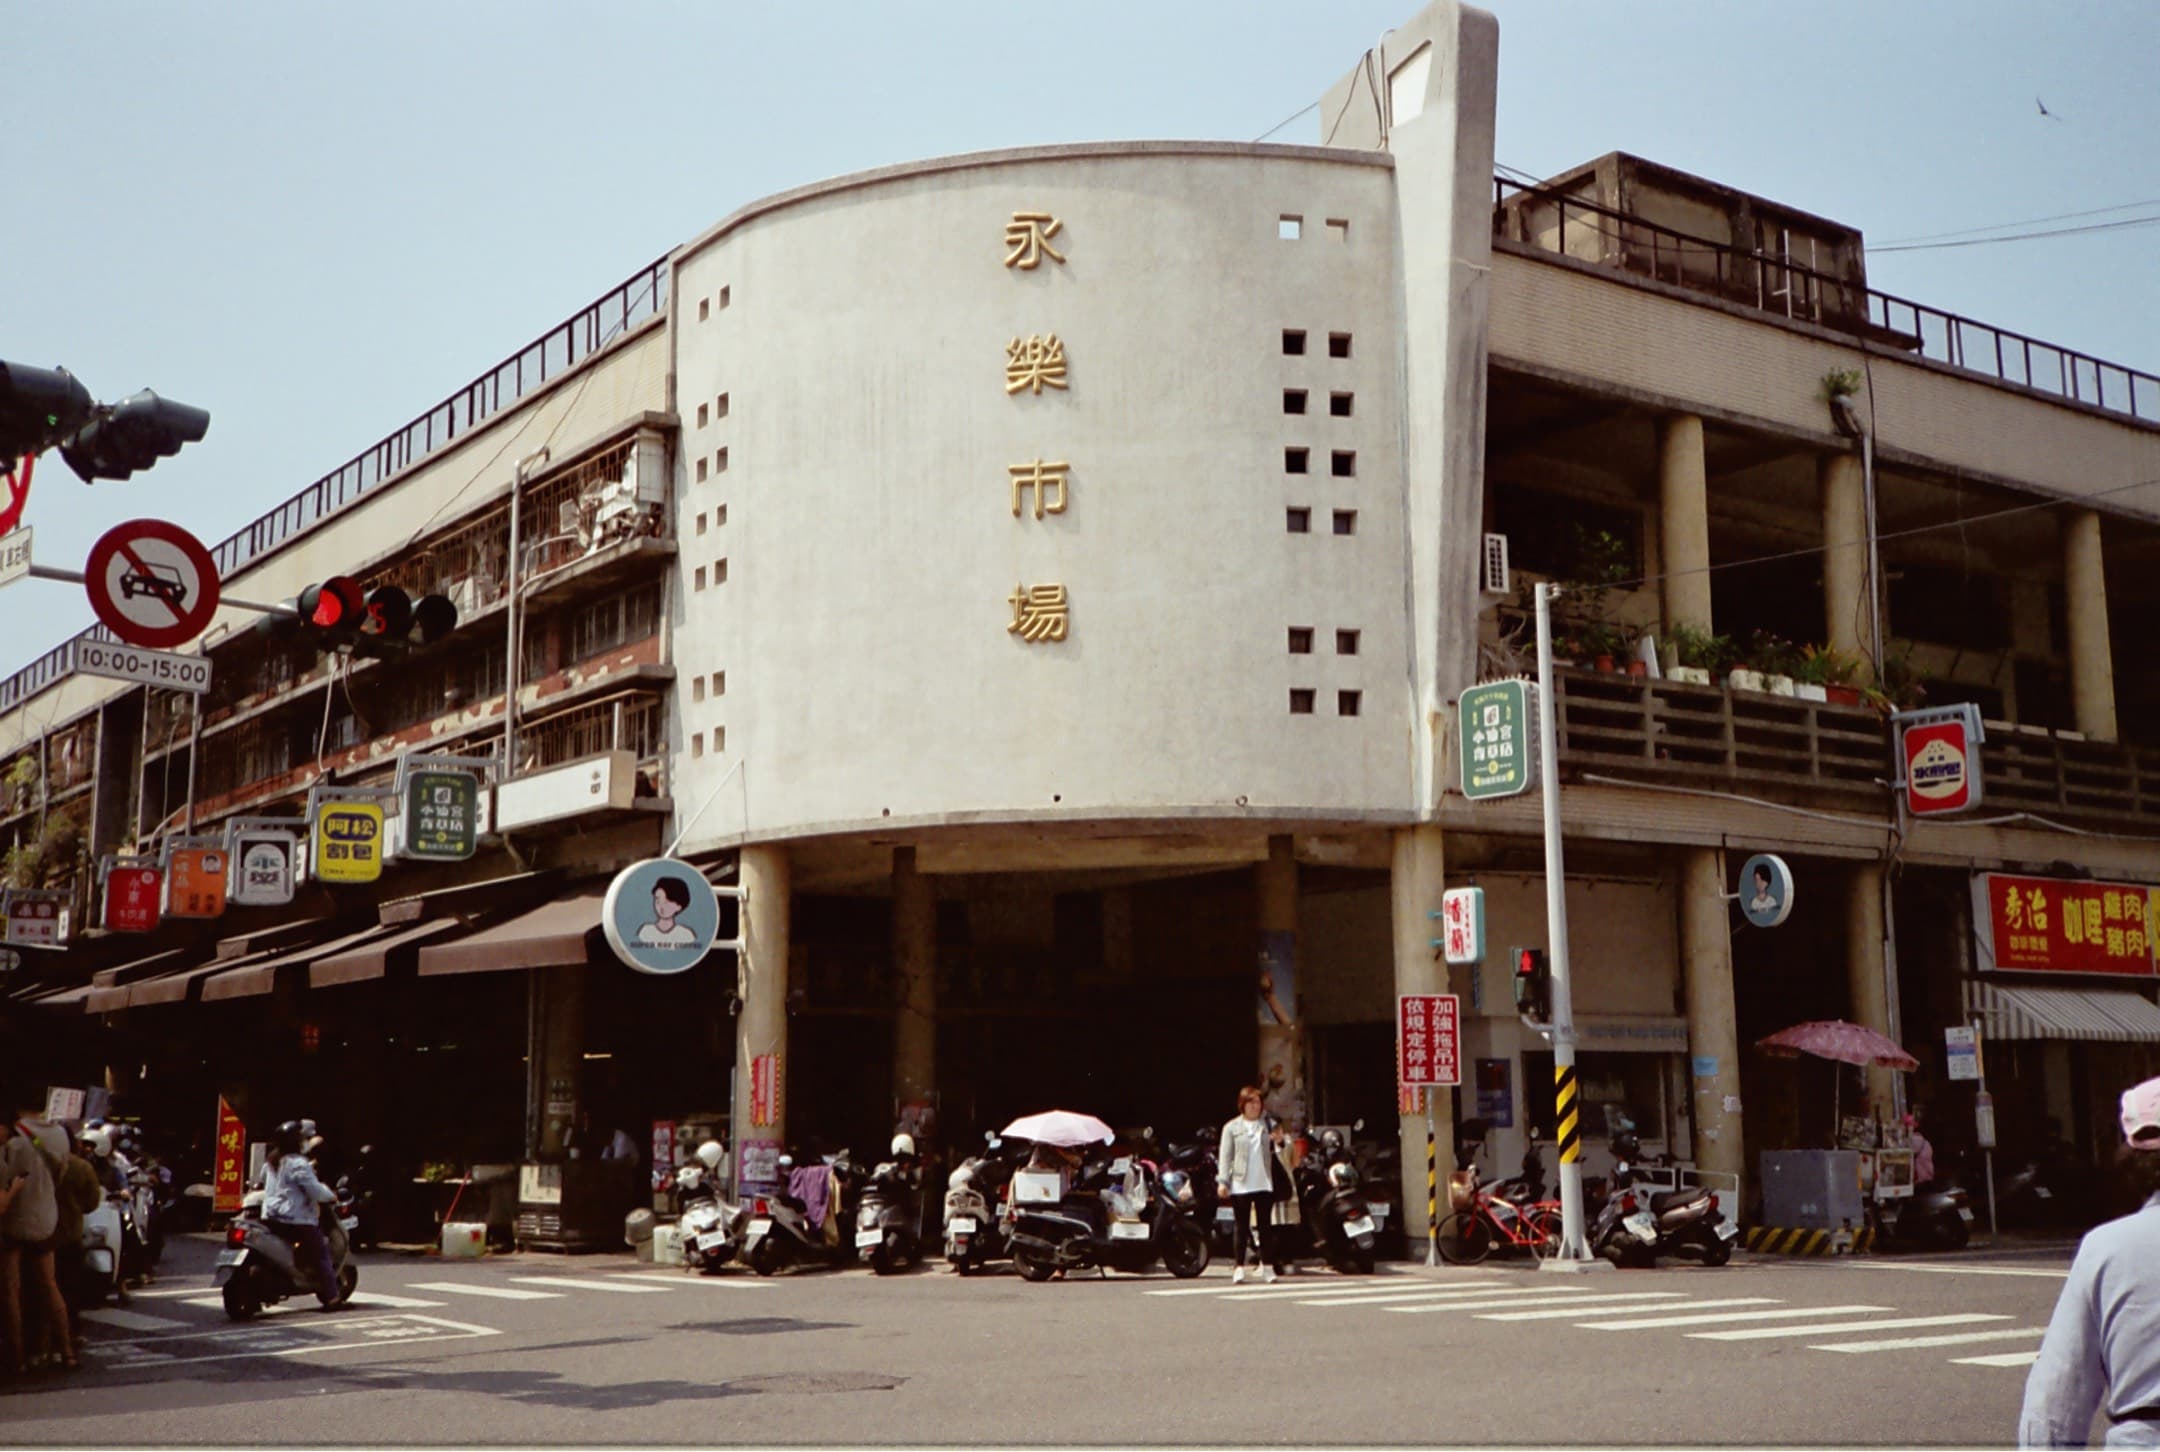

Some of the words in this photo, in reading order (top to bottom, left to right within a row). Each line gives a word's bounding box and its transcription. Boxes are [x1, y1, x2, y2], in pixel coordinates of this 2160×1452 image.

[1004, 211, 1070, 643] 永樂市場
[82, 646, 206, 683] 10:00-15:00
[327, 818, 373, 836] 阿松
[326, 842, 372, 859] 割包
[2063, 896, 2104, 944] 咖哩
[2104, 890, 2142, 921] 雞肉
[2106, 926, 2145, 957] 豬肉
[1406, 1000, 1427, 1080] 依規定停車
[1432, 1000, 1454, 1081] 加強拖吊區
[221, 1115, 240, 1181] 一味品
